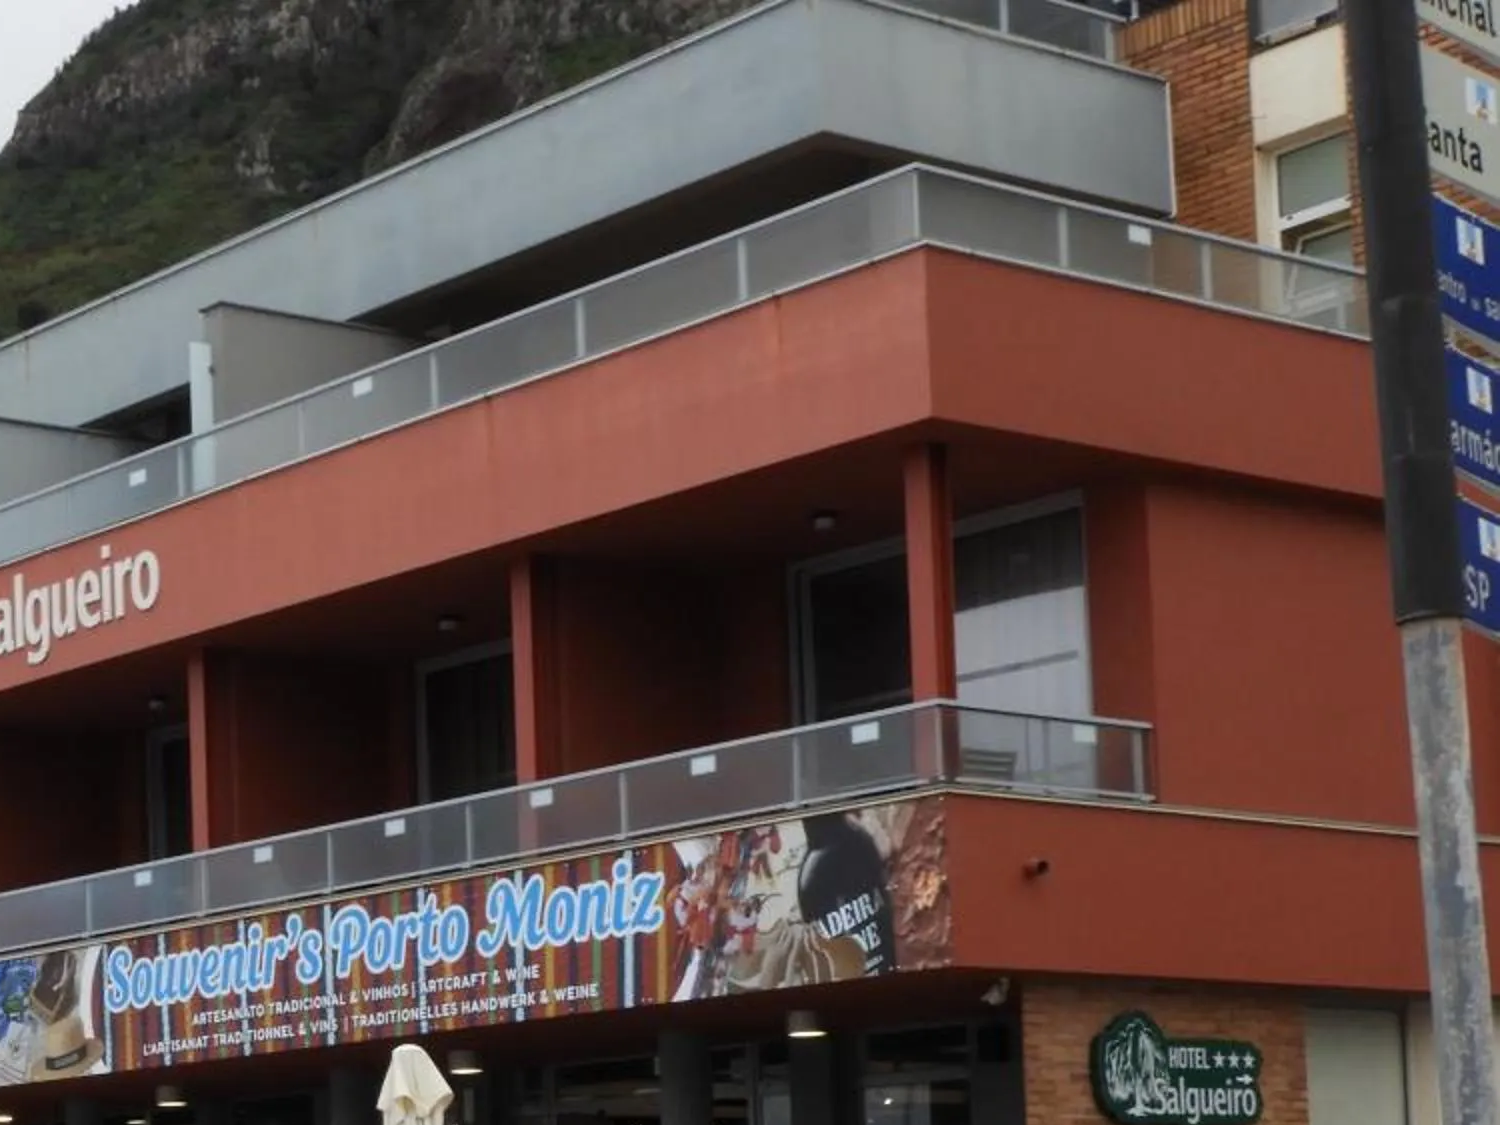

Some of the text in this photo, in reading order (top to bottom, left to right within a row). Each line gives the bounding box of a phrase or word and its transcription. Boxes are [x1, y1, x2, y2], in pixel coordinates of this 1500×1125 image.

[1429, 121, 1483, 175] anta
[105, 858, 664, 1013] Souvenir's Porto Moniz
[142, 1033, 210, 1057] L'ARTISANAT
[309, 1017, 339, 1035] VINS
[352, 1001, 458, 1029] TRADITIONELLES
[460, 990, 535, 1015] HANDWERK
[552, 982, 600, 1002] WEINE
[191, 1005, 265, 1026] ARTESANATO
[267, 994, 346, 1018] TRADICIONAL
[361, 982, 409, 1003] VINHOS
[419, 972, 487, 995] ARTCRAFT
[504, 963, 541, 983] WINE
[1168, 1046, 1211, 1069] HOTEL
[1154, 1075, 1258, 1125] Salgueiro
